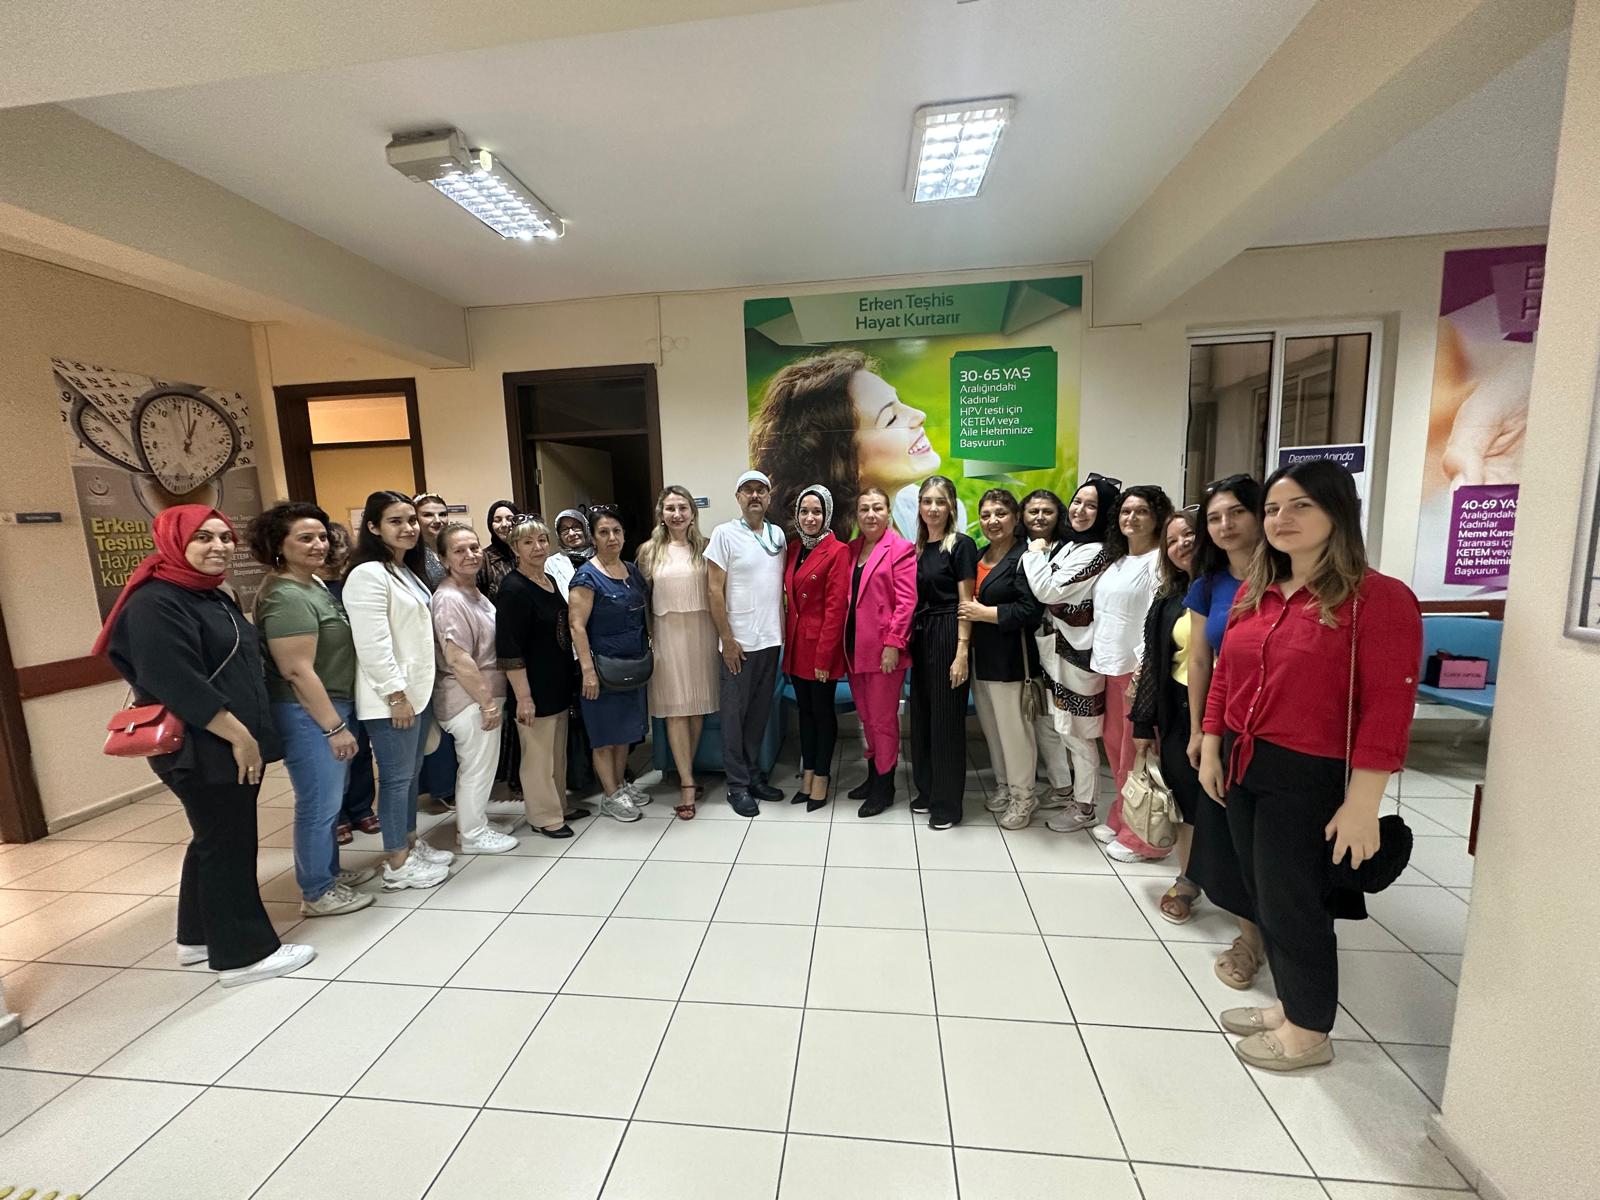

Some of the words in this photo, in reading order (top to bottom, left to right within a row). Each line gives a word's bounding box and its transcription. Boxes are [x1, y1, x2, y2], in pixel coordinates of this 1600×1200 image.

[859, 297, 903, 312] Erken
[905, 292, 954, 311] Teşhis
[855, 315, 901, 331] Hayat
[903, 312, 960, 327] Kurtarır
[960, 370, 1000, 382] 30-65
[1003, 367, 1031, 381] YAŞ
[960, 382, 1017, 394] Aralığındaki
[960, 395, 999, 404] Kadınlar
[960, 406, 982, 416] HPV
[984, 405, 1004, 415] testi
[1006, 405, 1023, 415] için
[960, 417, 995, 427] KETEM
[997, 418, 1020, 427] veya
[960, 428, 978, 437] Aile
[980, 427, 1034, 436] Hekiminize
[960, 439, 1007, 448] Başvurun.
[1461, 500, 1497, 510] 40-69
[1499, 499, 1517, 509] YA
[1460, 510, 1517, 520] Aralığındak
[91, 517, 147, 534] Erken
[1459, 520, 1498, 529] Kadınlar
[1458, 530, 1488, 538] Meme
[1489, 529, 1514, 537] Kans
[95, 535, 155, 554] Teşhis
[1457, 539, 1499, 547] Taraması
[1501, 540, 1512, 548] içi
[1456, 548, 1490, 557] KETEM
[1455, 558, 1474, 566] Aile
[1454, 567, 1499, 577] Başvurun.
[101, 570, 133, 587] Kur
